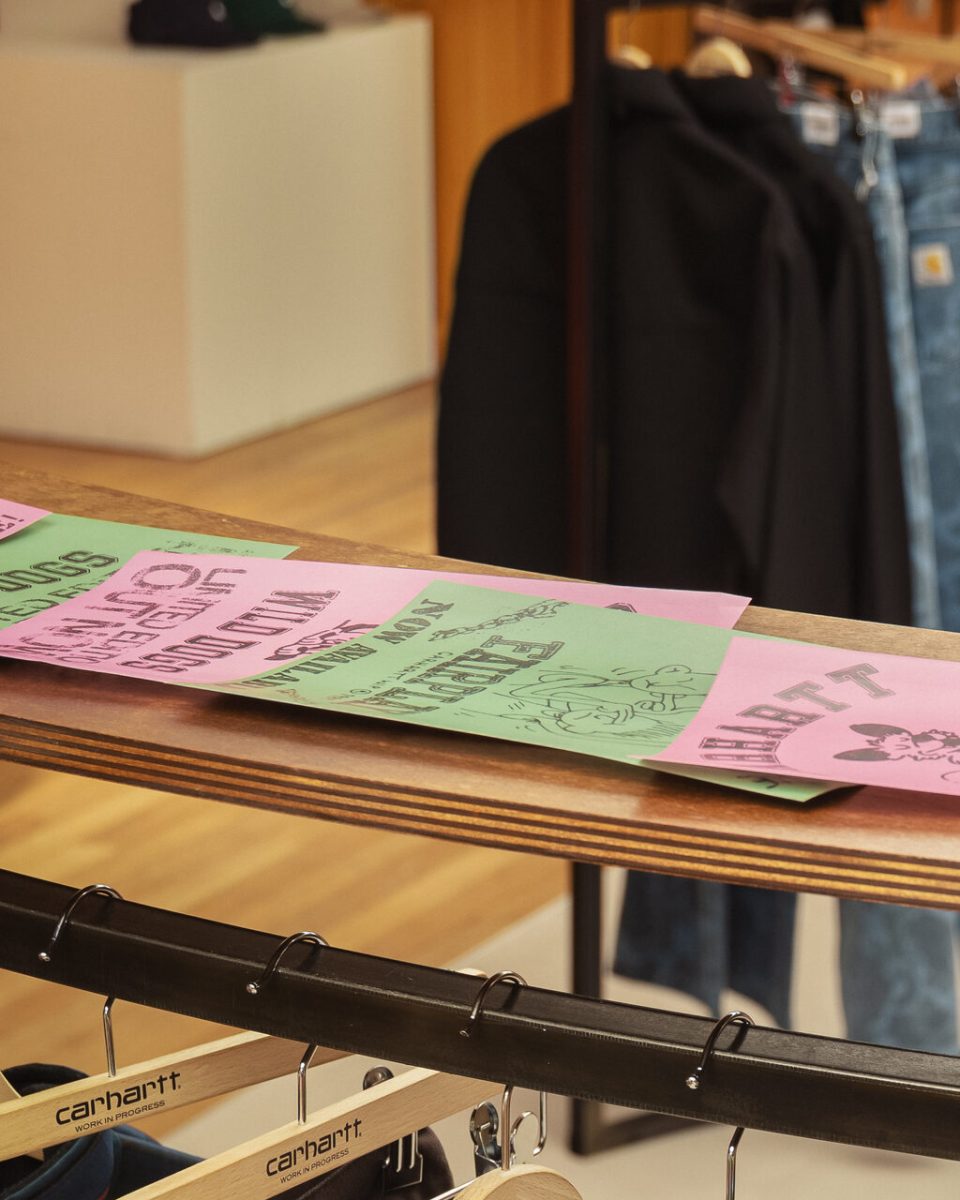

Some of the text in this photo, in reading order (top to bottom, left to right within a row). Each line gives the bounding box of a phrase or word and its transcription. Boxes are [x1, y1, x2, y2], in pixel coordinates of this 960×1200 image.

[117, 590, 342, 674] WILD DOGS
[373, 598, 455, 645] NOW
[55, 1071, 181, 1126] carhartt
[74, 1100, 166, 1133] WORK IN PROGRESS
[266, 1118, 362, 1177] carhartt
[280, 1148, 350, 1184] WORK IN PROGRESS
